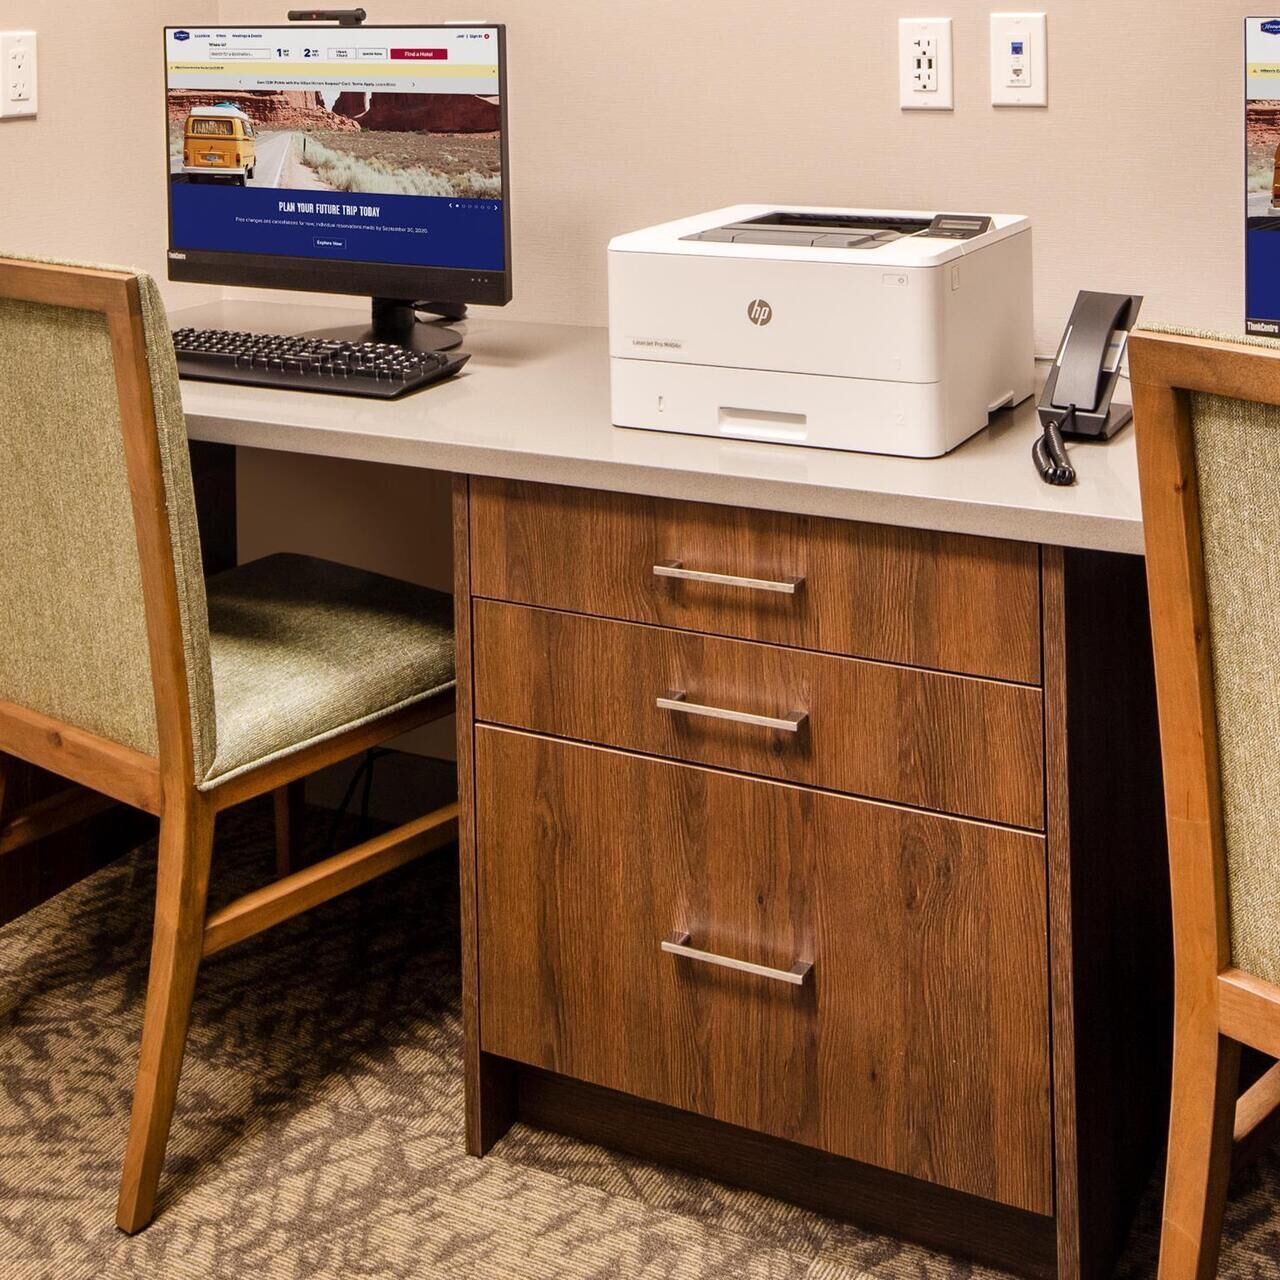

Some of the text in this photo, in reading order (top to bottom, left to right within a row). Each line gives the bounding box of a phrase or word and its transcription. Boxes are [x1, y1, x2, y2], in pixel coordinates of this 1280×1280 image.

[277, 48, 282, 57] 1
[304, 49, 310, 57] 2
[279, 201, 380, 217] PLAN YOUR FUTURE TRIP TODAY
[748, 298, 772, 326] hp
